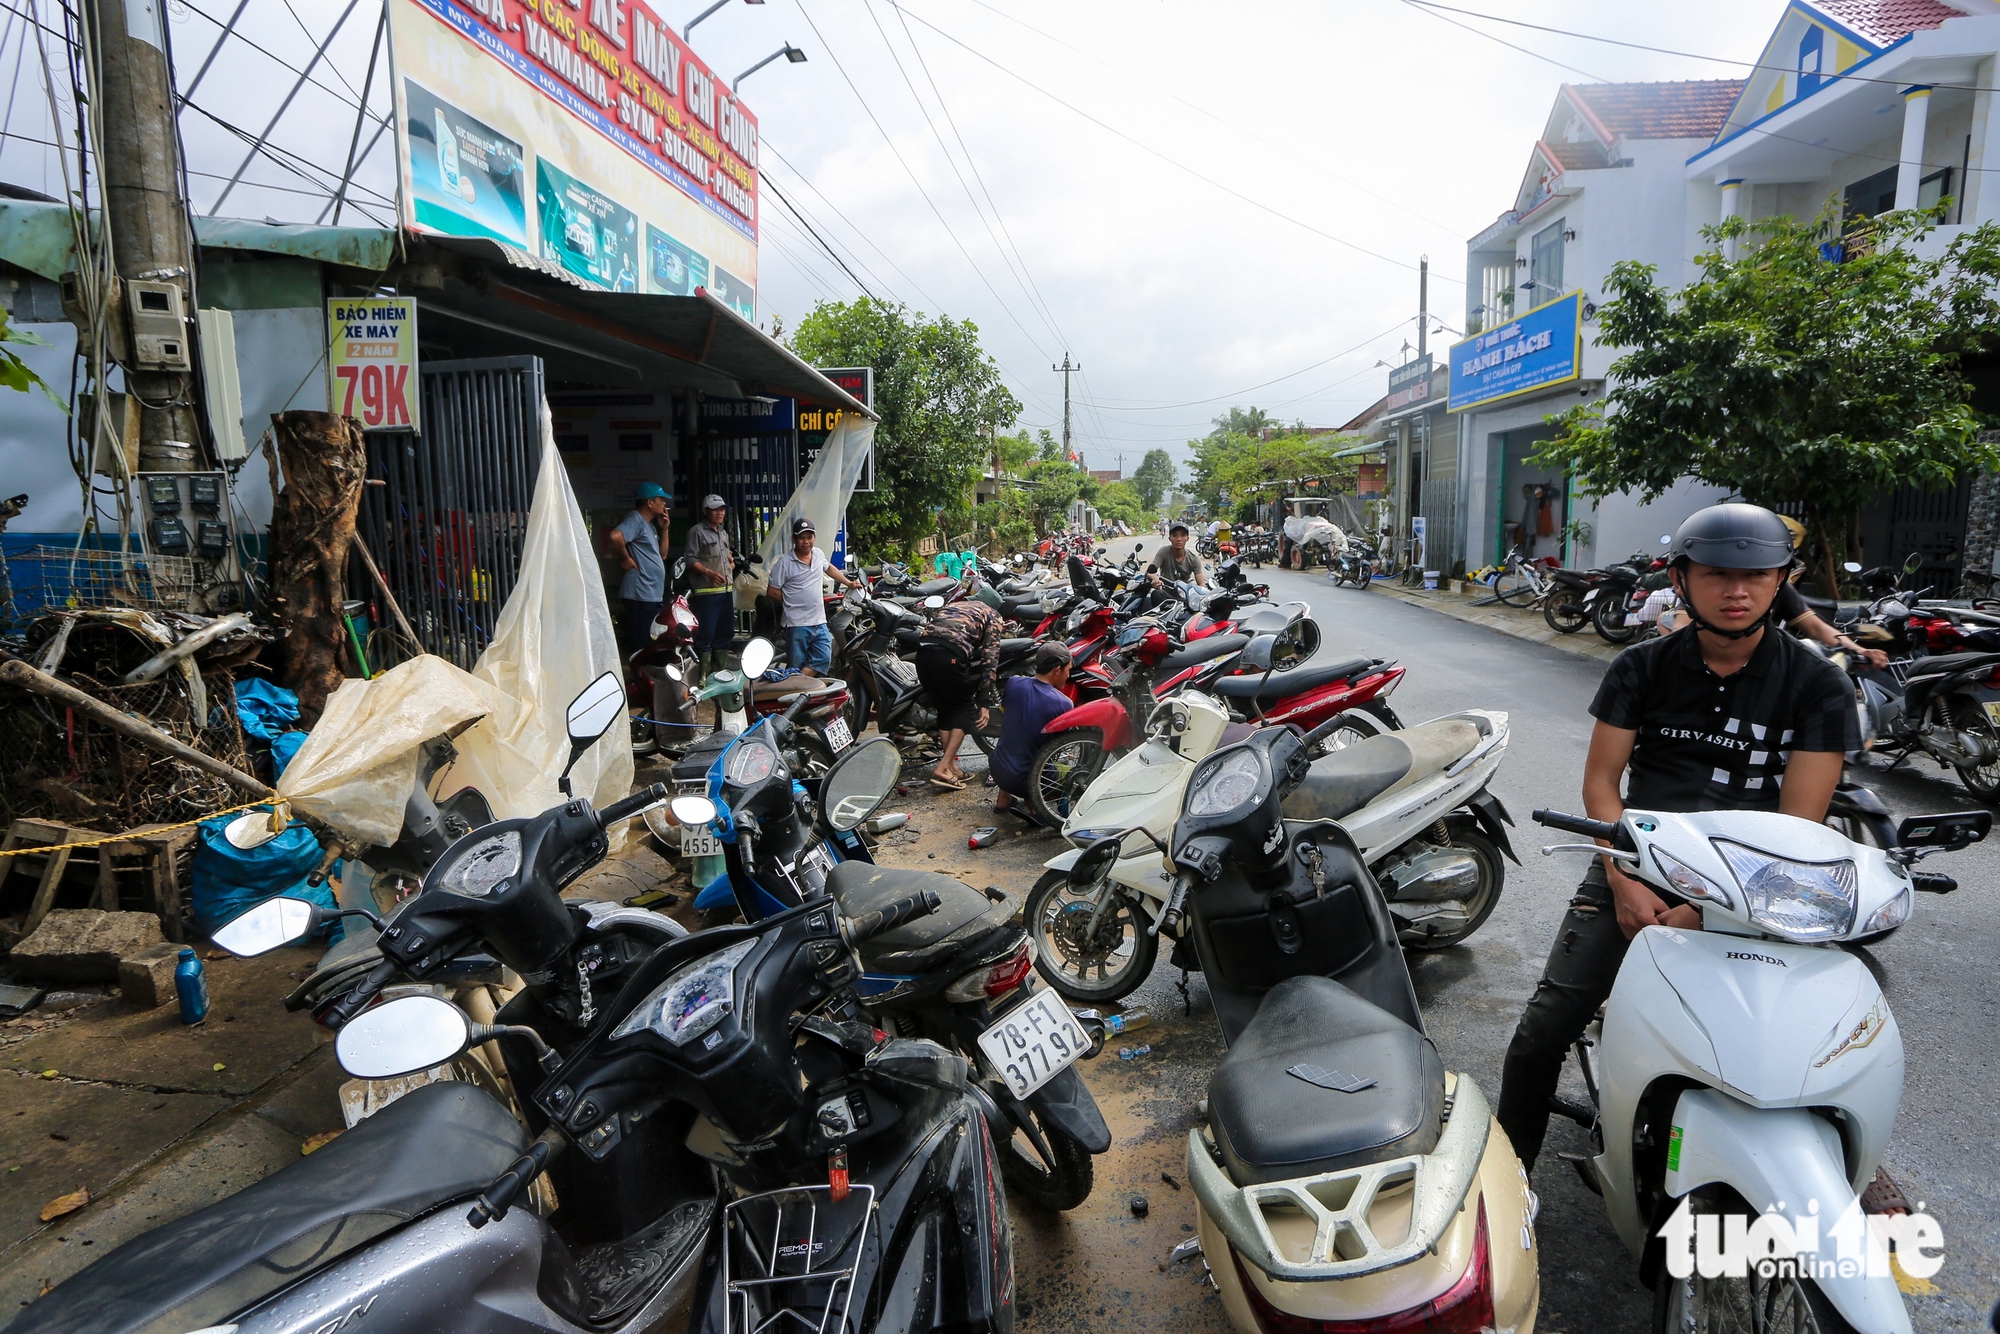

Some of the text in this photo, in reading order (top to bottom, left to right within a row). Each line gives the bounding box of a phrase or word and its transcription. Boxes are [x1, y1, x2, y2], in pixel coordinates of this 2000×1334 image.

[448, 6, 472, 30] MỸ
[476, 26, 515, 63] XUÂN
[519, 60, 528, 73] 2
[540, 73, 563, 99] HÒA
[567, 92, 599, 124] THỊNH
[607, 124, 627, 144] TÂY
[629, 139, 647, 161] HÒA
[654, 159, 671, 176] PHÚ
[672, 172, 688, 189] YÊN
[544, 0, 576, 40] CÁC
[579, 28, 620, 78] DÒNG
[622, 64, 641, 97] XE
[642, 83, 665, 116] TAY
[666, 106, 682, 129] GA
[688, 122, 700, 146] XE
[702, 137, 721, 162] MÁY
[721, 152, 734, 175] XE
[735, 163, 753, 192] ĐIỆN
[634, 7, 681, 97] MÁY
[687, 62, 716, 131] CHÍ
[720, 94, 758, 169] CÔNG
[523, 13, 610, 109] YAMAHA
[618, 92, 656, 144] SYM
[663, 127, 709, 185] SUZUKI
[715, 169, 754, 221] PIAGGIO
[336, 301, 406, 321] BẢO HIỂM
[345, 322, 399, 339] XE MÁY
[351, 343, 394, 357] 2 NĂM
[1462, 348, 1503, 377] HẠNH
[1503, 329, 1553, 362] BÁCH
[336, 364, 412, 426] 79K
[800, 409, 822, 431] CHÍ
[1660, 727, 1750, 751] GIRVASHY
[1726, 951, 1788, 968] HONDA
[992, 1000, 1057, 1058] 78-F1
[1006, 1022, 1085, 1091] 377.92
